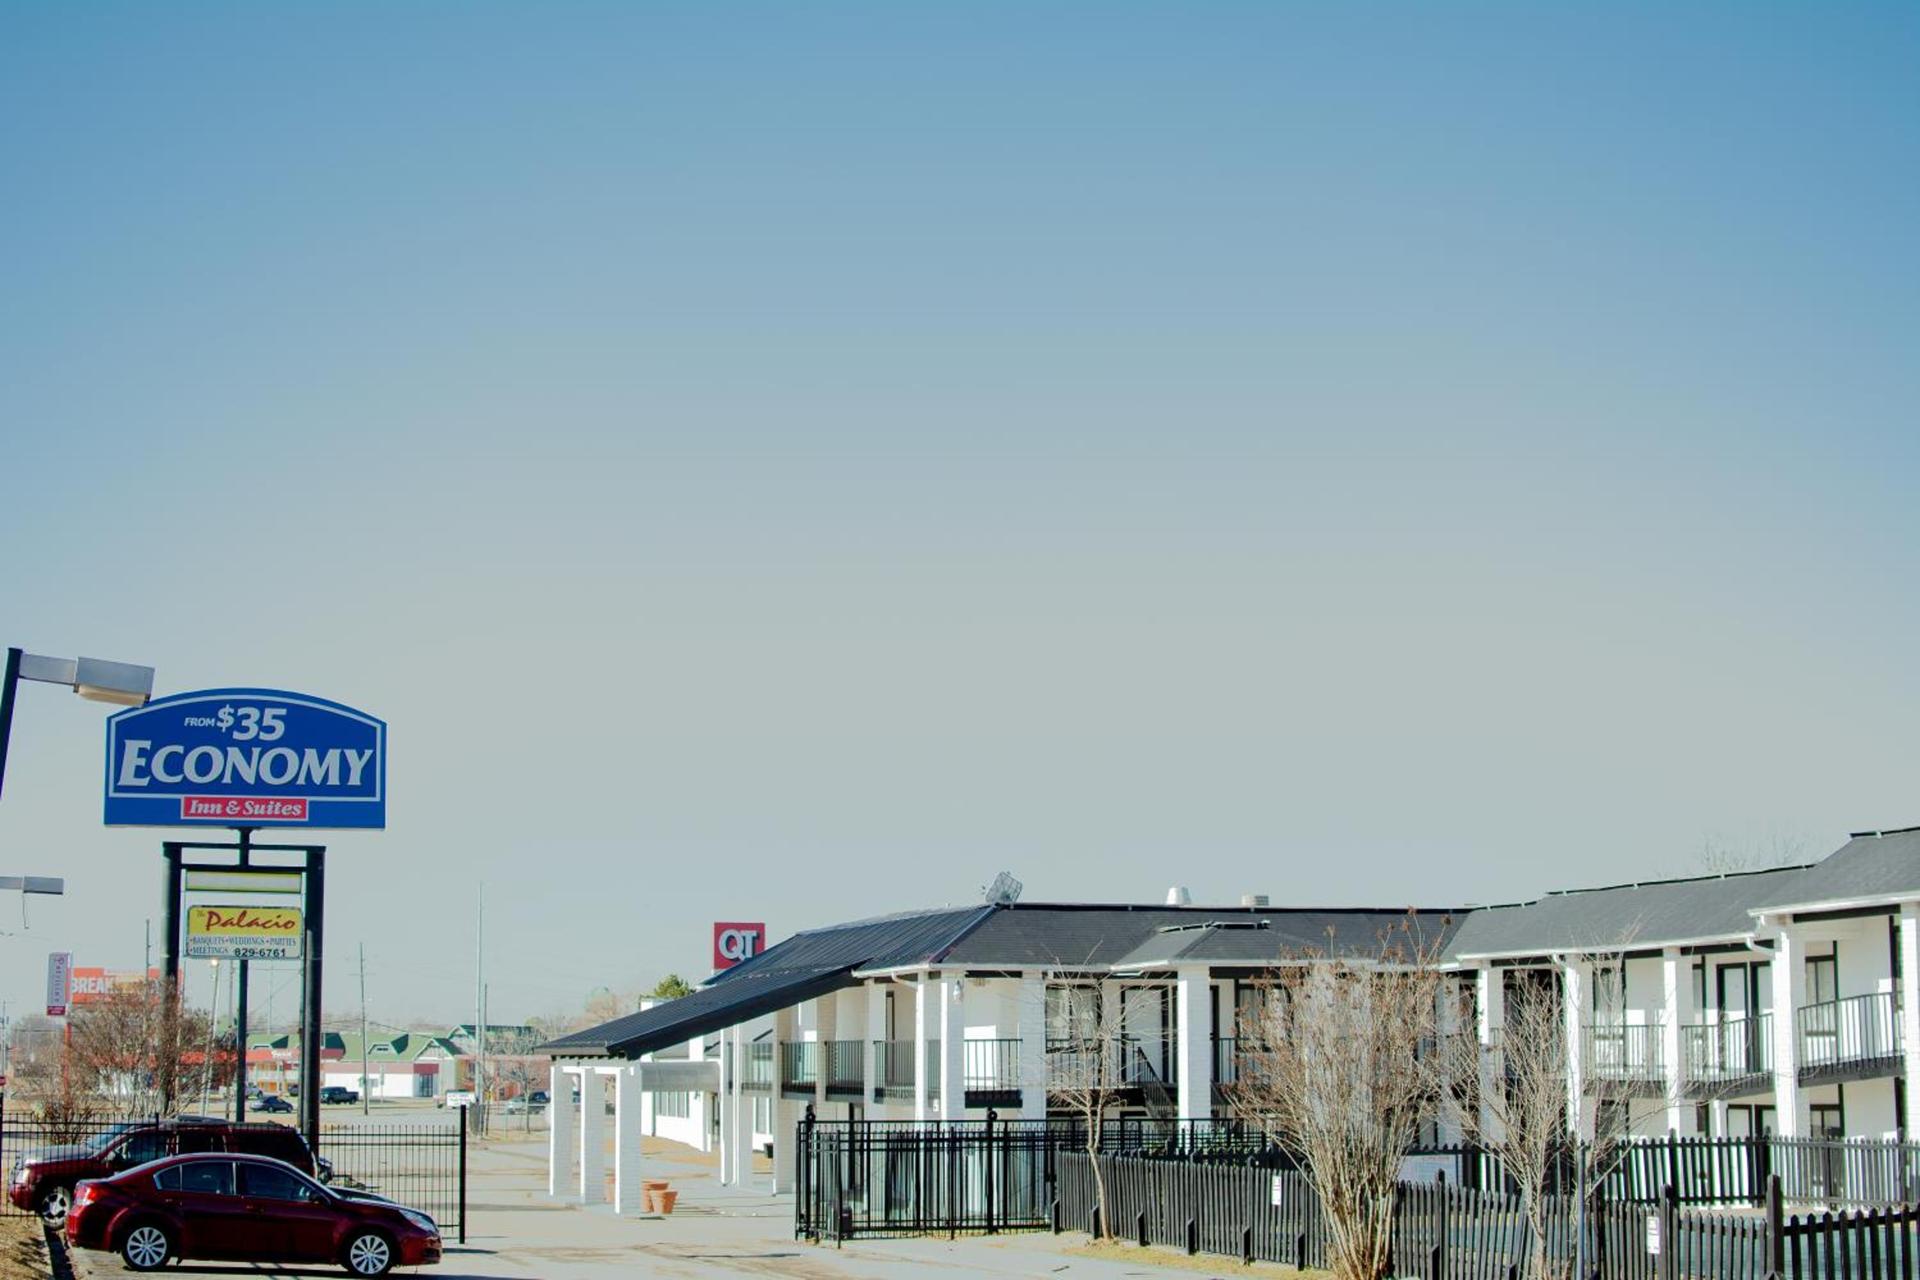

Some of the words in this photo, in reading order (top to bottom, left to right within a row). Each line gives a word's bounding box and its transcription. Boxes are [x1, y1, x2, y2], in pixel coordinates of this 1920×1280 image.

[184, 717, 215, 727] FROM
[216, 704, 287, 741] $35
[117, 739, 374, 787] ECONOMY
[189, 800, 222, 815] Inn
[225, 801, 241, 815] &
[243, 800, 302, 816] Suites
[205, 910, 296, 931] Palacio
[234, 947, 286, 958] 829-6761
[719, 929, 758, 961] QT
